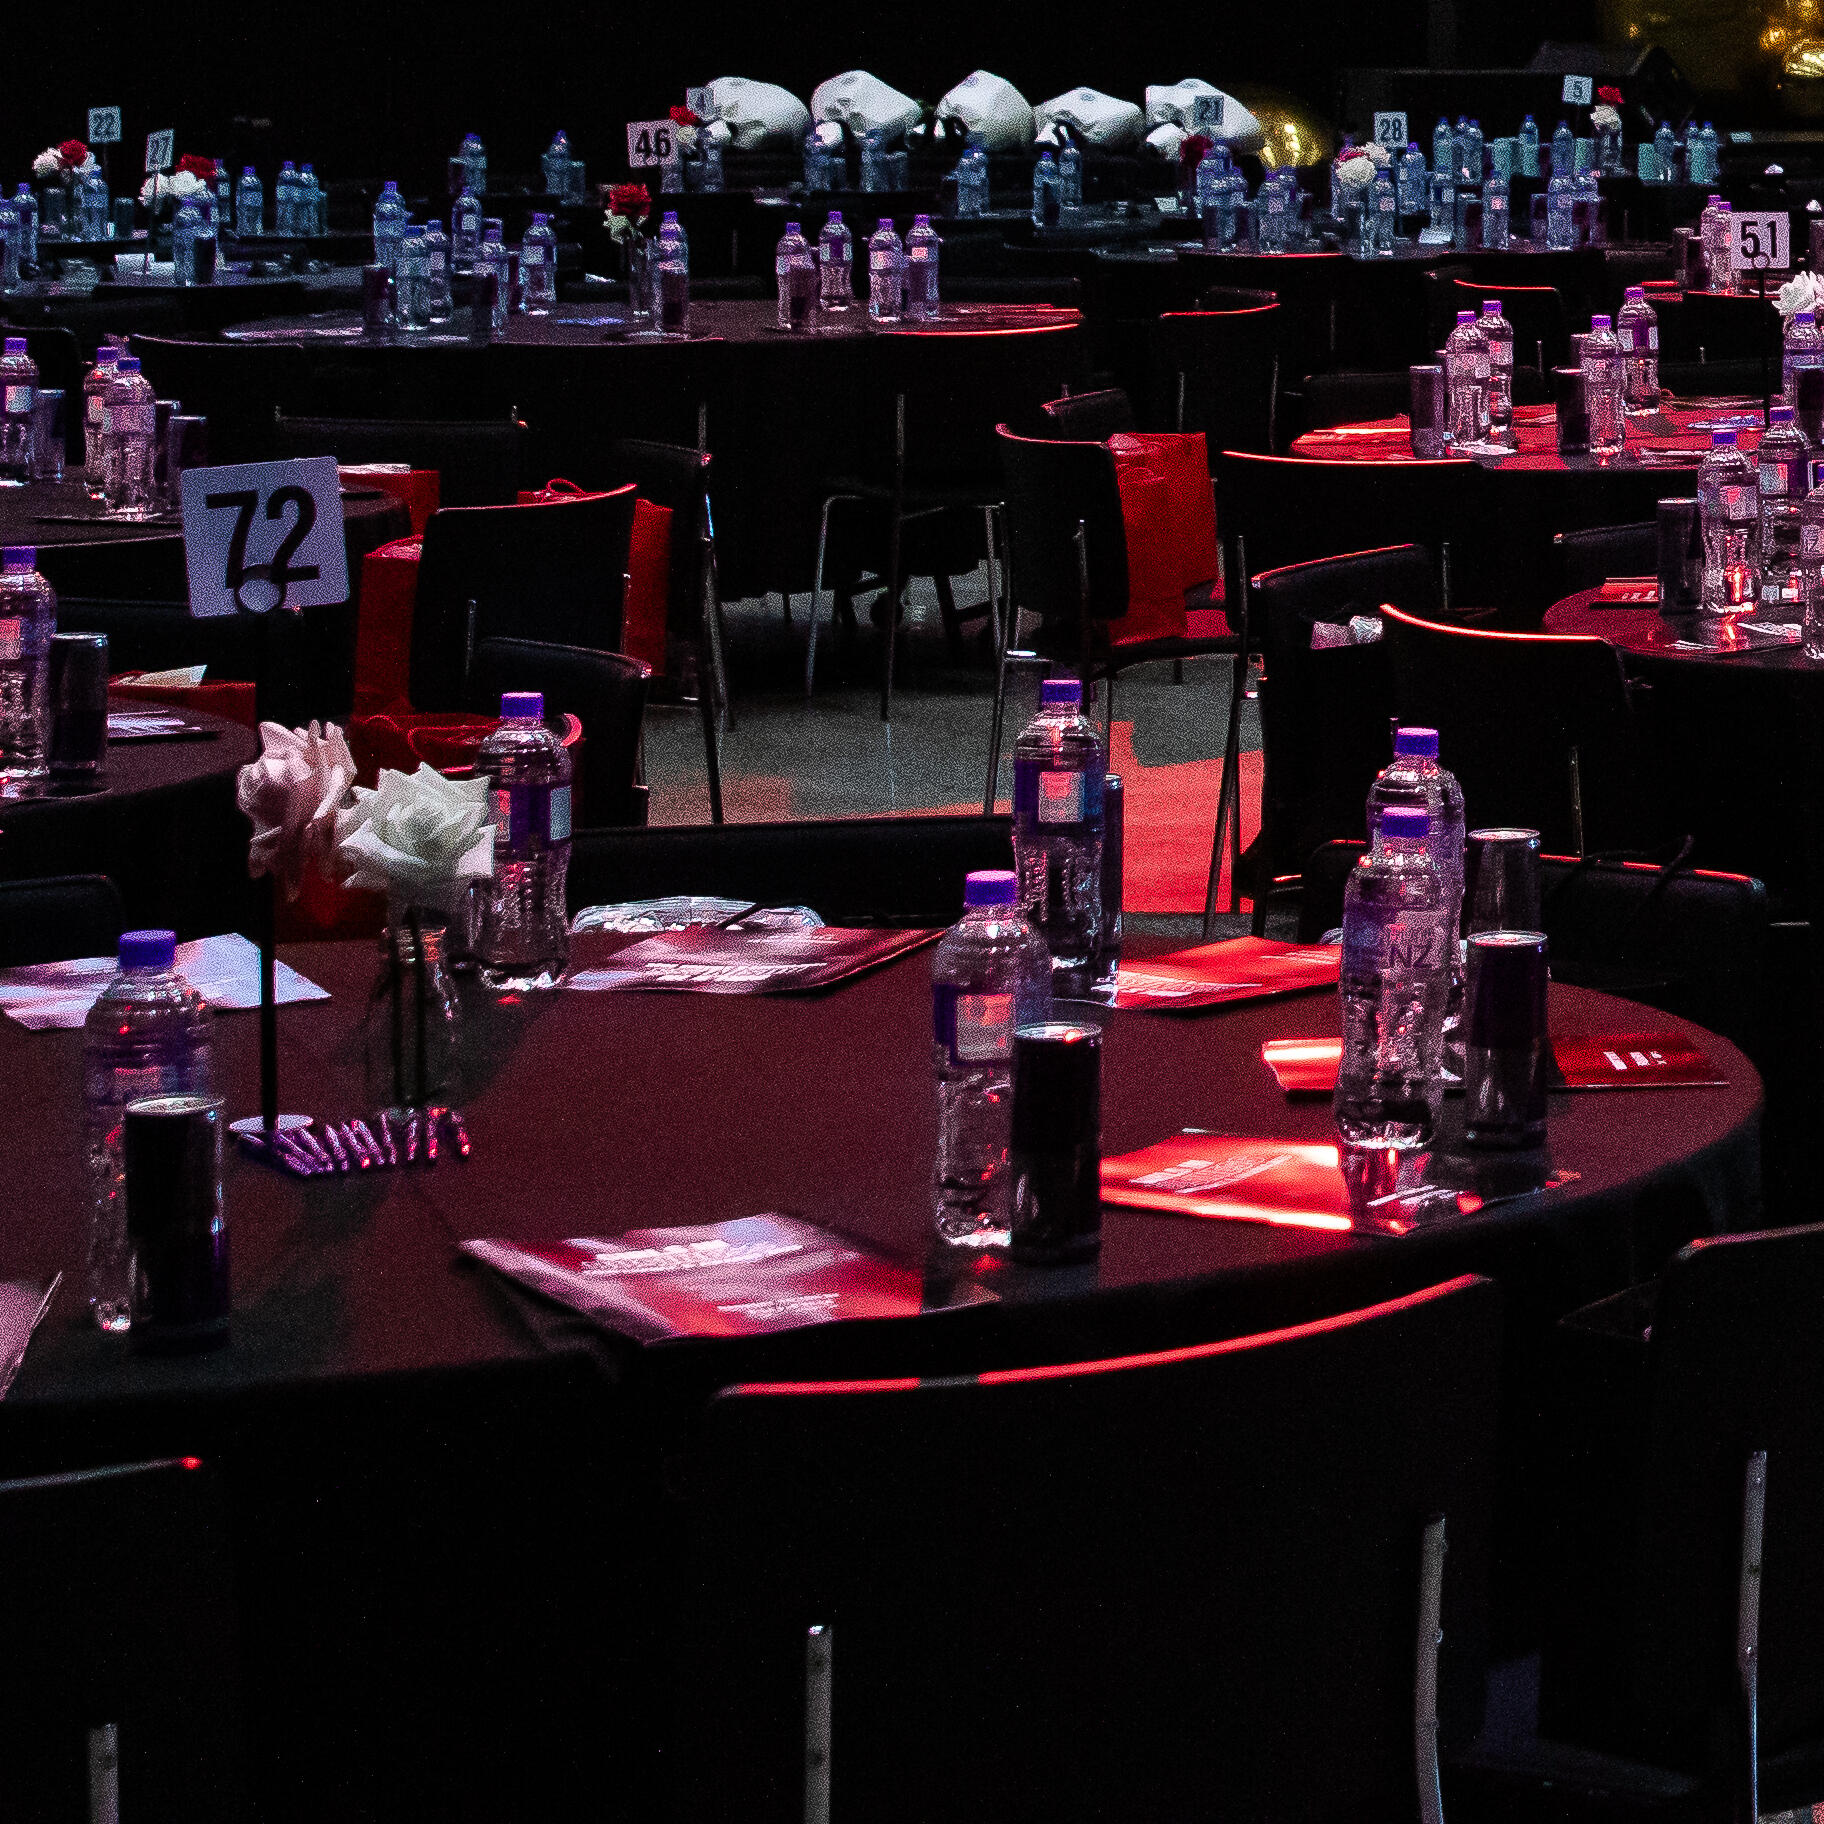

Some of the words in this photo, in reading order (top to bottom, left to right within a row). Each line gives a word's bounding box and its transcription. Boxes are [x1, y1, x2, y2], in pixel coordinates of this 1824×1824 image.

[695, 92, 707, 111] 4
[1572, 80, 1583, 98] 5
[1199, 99, 1220, 121] 21
[93, 112, 116, 137] 22
[1380, 118, 1403, 143] 28
[150, 135, 171, 164] 27
[635, 128, 671, 159] 46
[1741, 220, 1778, 258] 51
[205, 485, 321, 589] 72
